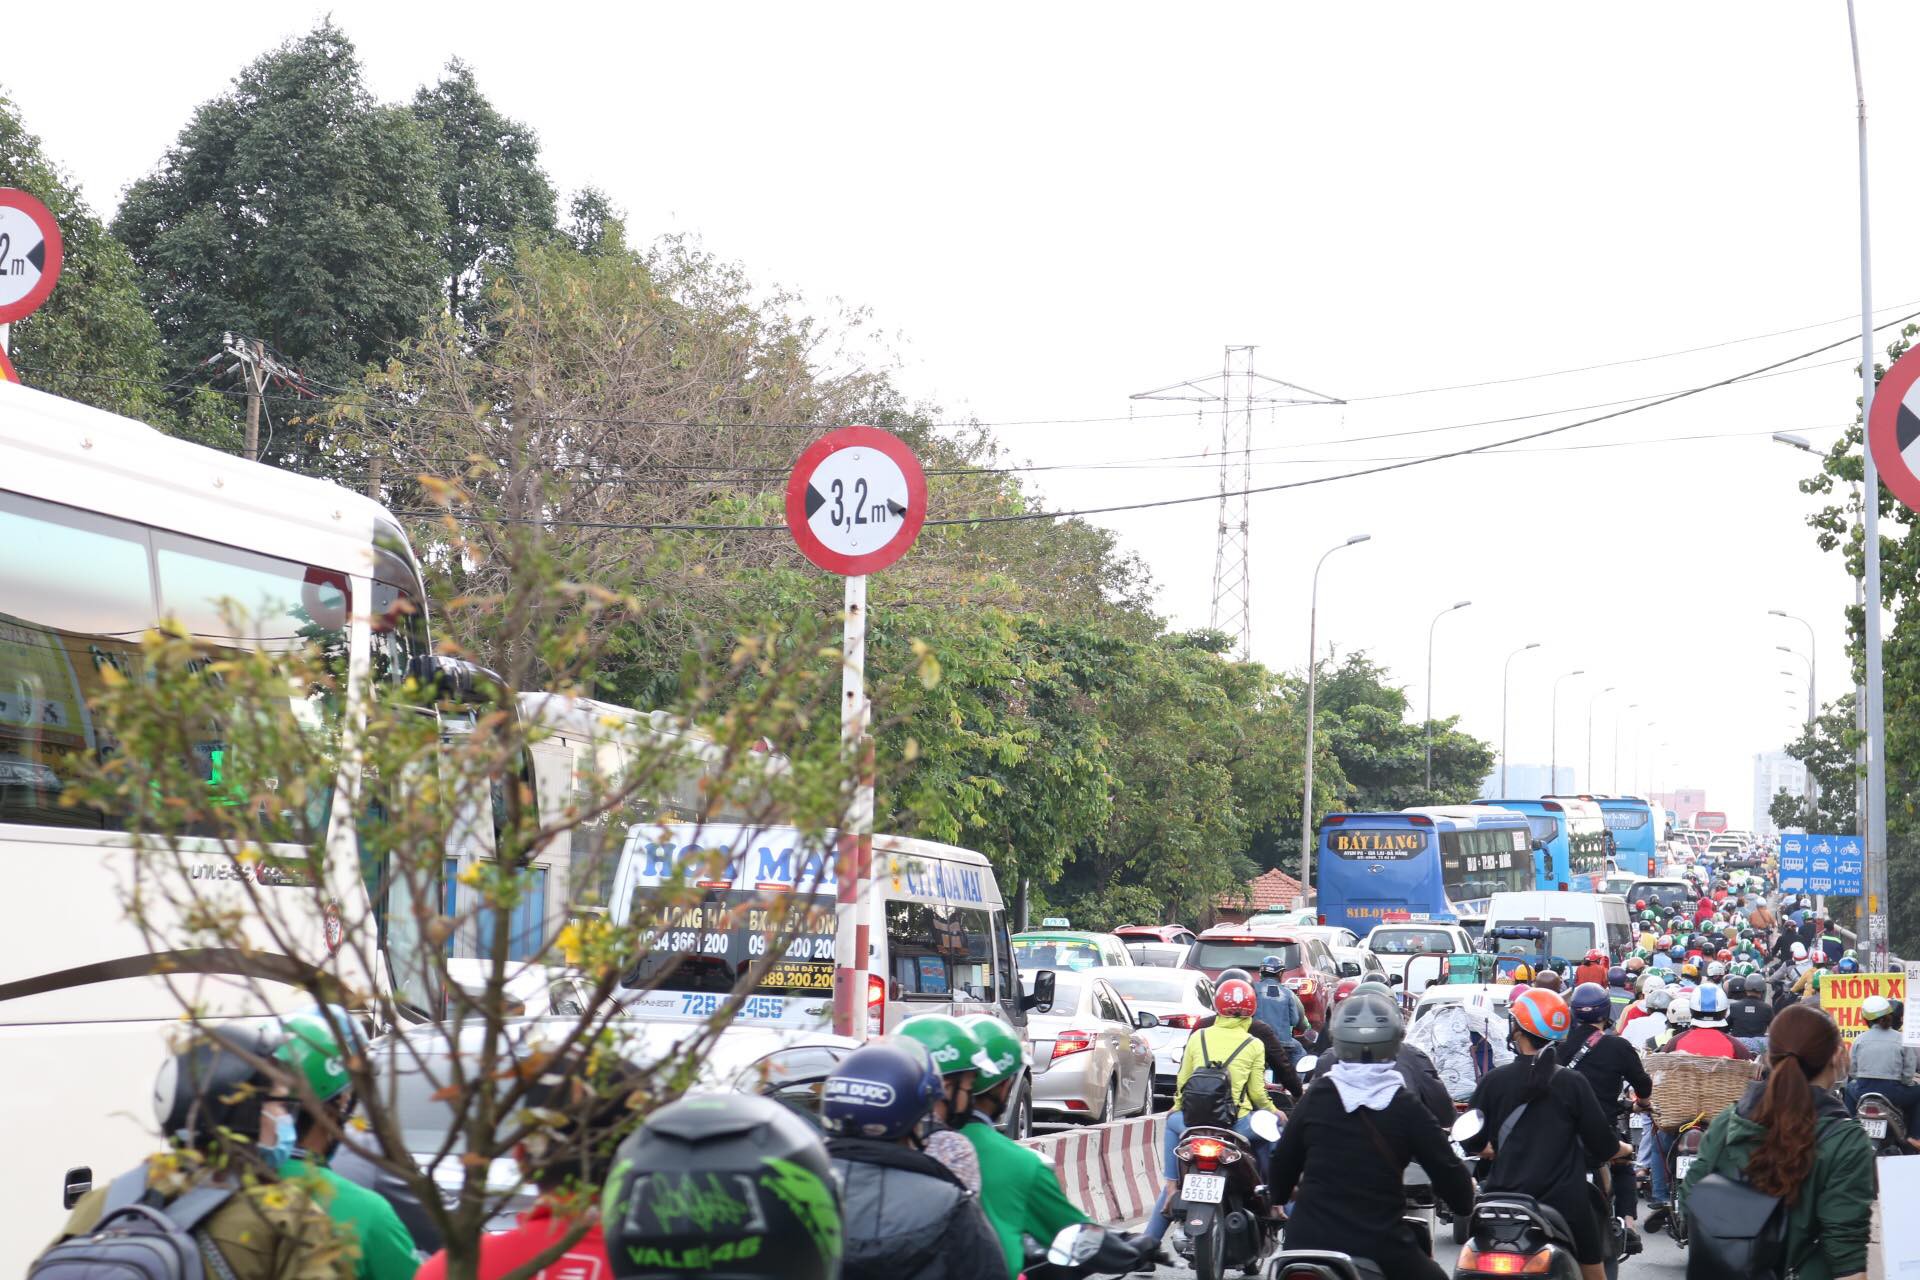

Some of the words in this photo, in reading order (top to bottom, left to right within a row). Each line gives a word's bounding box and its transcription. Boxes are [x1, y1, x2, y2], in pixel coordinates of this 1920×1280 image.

[831, 477, 886, 534] 3,2m
[1374, 834, 1417, 850] LANG
[664, 907, 703, 929] LONG
[704, 933, 729, 954] 200
[785, 937, 812, 958] 200
[1831, 975, 1880, 1000] NÓN
[1190, 1176, 1218, 1189] 82-B1
